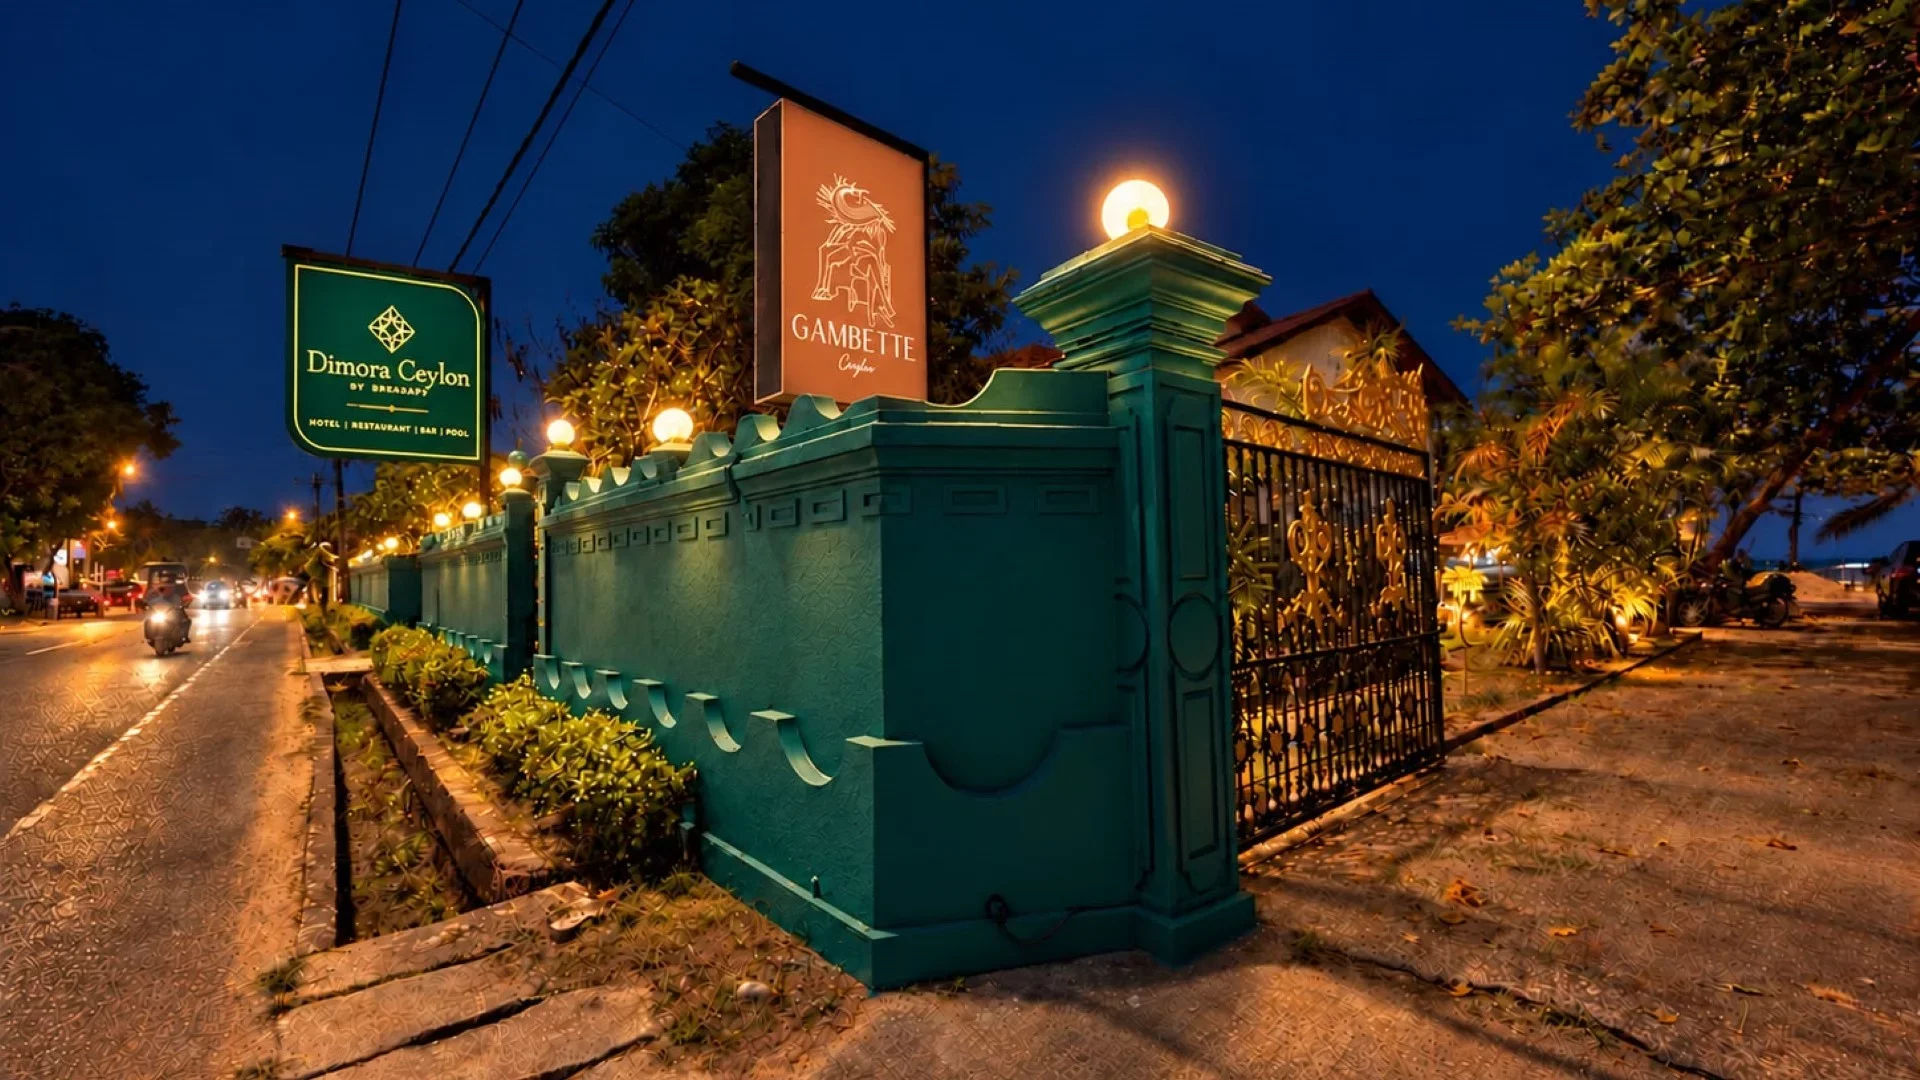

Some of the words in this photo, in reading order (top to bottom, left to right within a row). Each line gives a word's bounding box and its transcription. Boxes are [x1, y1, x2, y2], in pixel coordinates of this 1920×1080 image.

[791, 313, 916, 362] GAMBETTE
[306, 349, 391, 379] Dimora
[398, 359, 471, 389] Ceylon
[349, 382, 364, 391] BY
[308, 418, 341, 428] HOTEL
[351, 421, 411, 433] RESTAURANT
[420, 426, 437, 435] BAR
[445, 428, 470, 438] POOL
